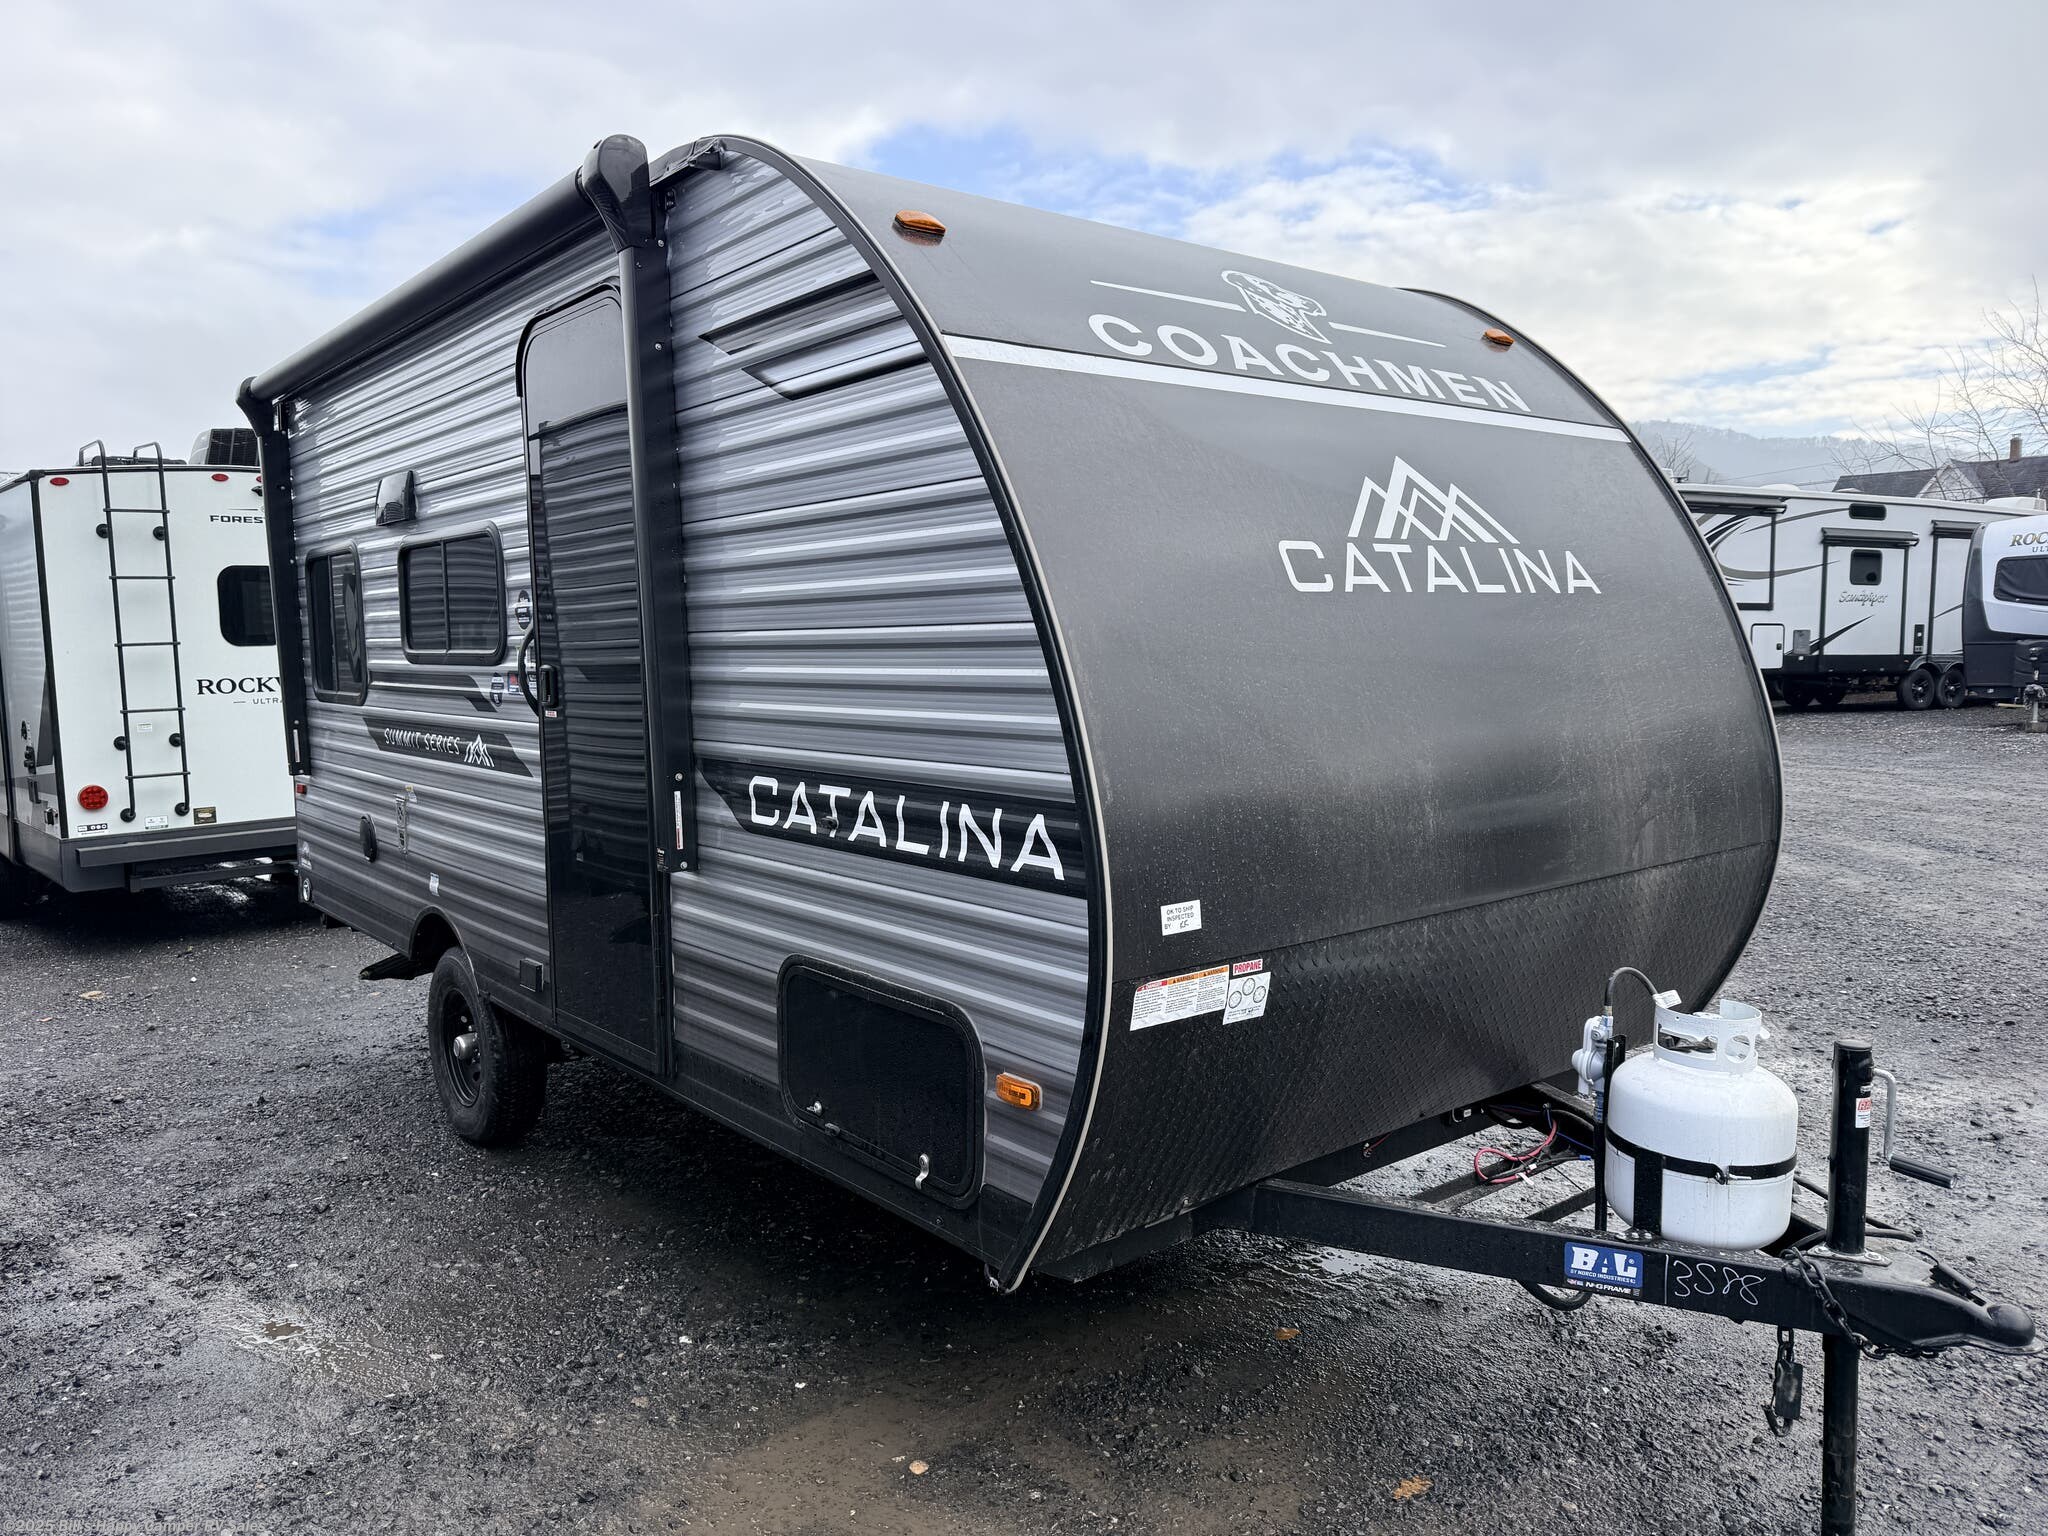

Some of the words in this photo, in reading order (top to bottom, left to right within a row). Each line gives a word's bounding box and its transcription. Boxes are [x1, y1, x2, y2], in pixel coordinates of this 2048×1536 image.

[1088, 313, 1531, 412] COACHMEN
[1278, 540, 1602, 594] CATALINA
[196, 676, 281, 696] ROCK
[252, 697, 282, 705] ULTR
[384, 727, 421, 750] SUMMIT
[424, 733, 460, 755] SERIES
[747, 775, 1065, 880] CATALINA
[1166, 911, 1195, 922] INSPECTED
[1234, 959, 1262, 974] PROPANE
[1570, 1246, 1637, 1278] BAL
[1578, 1270, 1597, 1278] NORCO
[1597, 1273, 1630, 1284] INDUSTRIES
[1604, 1284, 1632, 1294] FRAME
